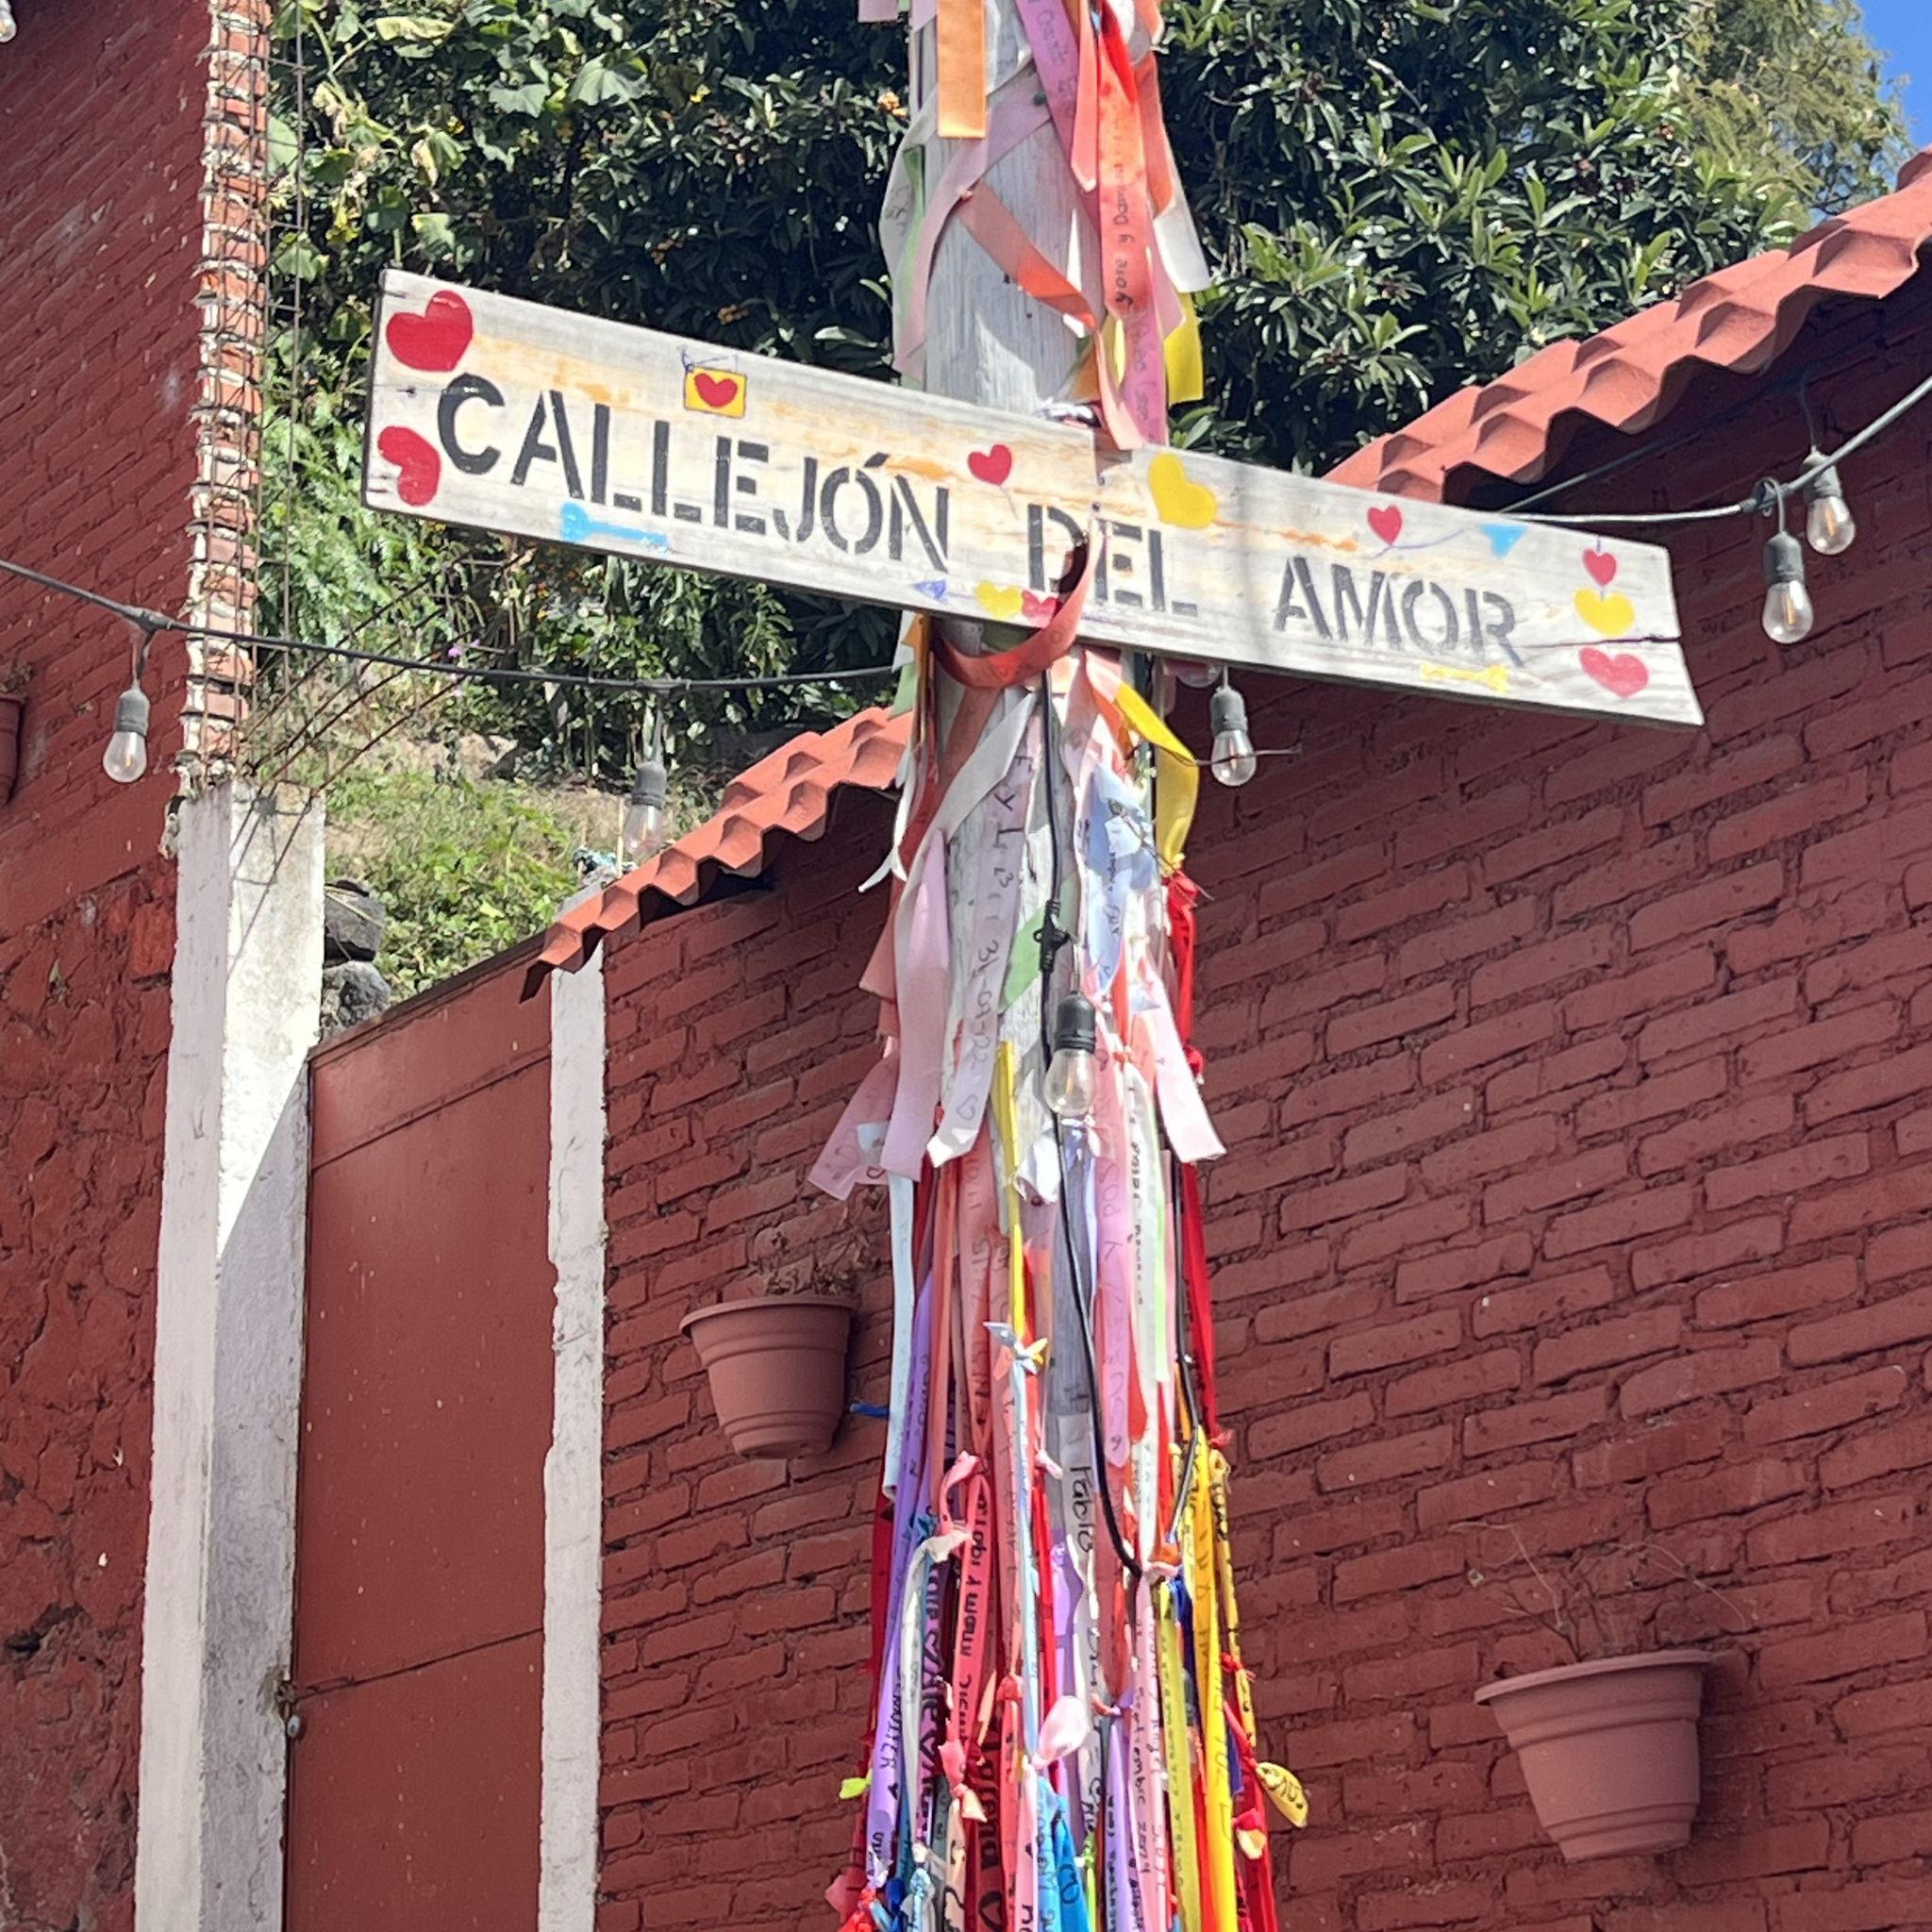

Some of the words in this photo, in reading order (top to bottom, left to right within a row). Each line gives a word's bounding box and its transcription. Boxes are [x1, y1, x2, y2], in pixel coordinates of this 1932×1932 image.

[436, 372, 949, 574] CALLEJÓN
[1026, 503, 1199, 618] DEL
[1273, 555, 1524, 668] AMOR
